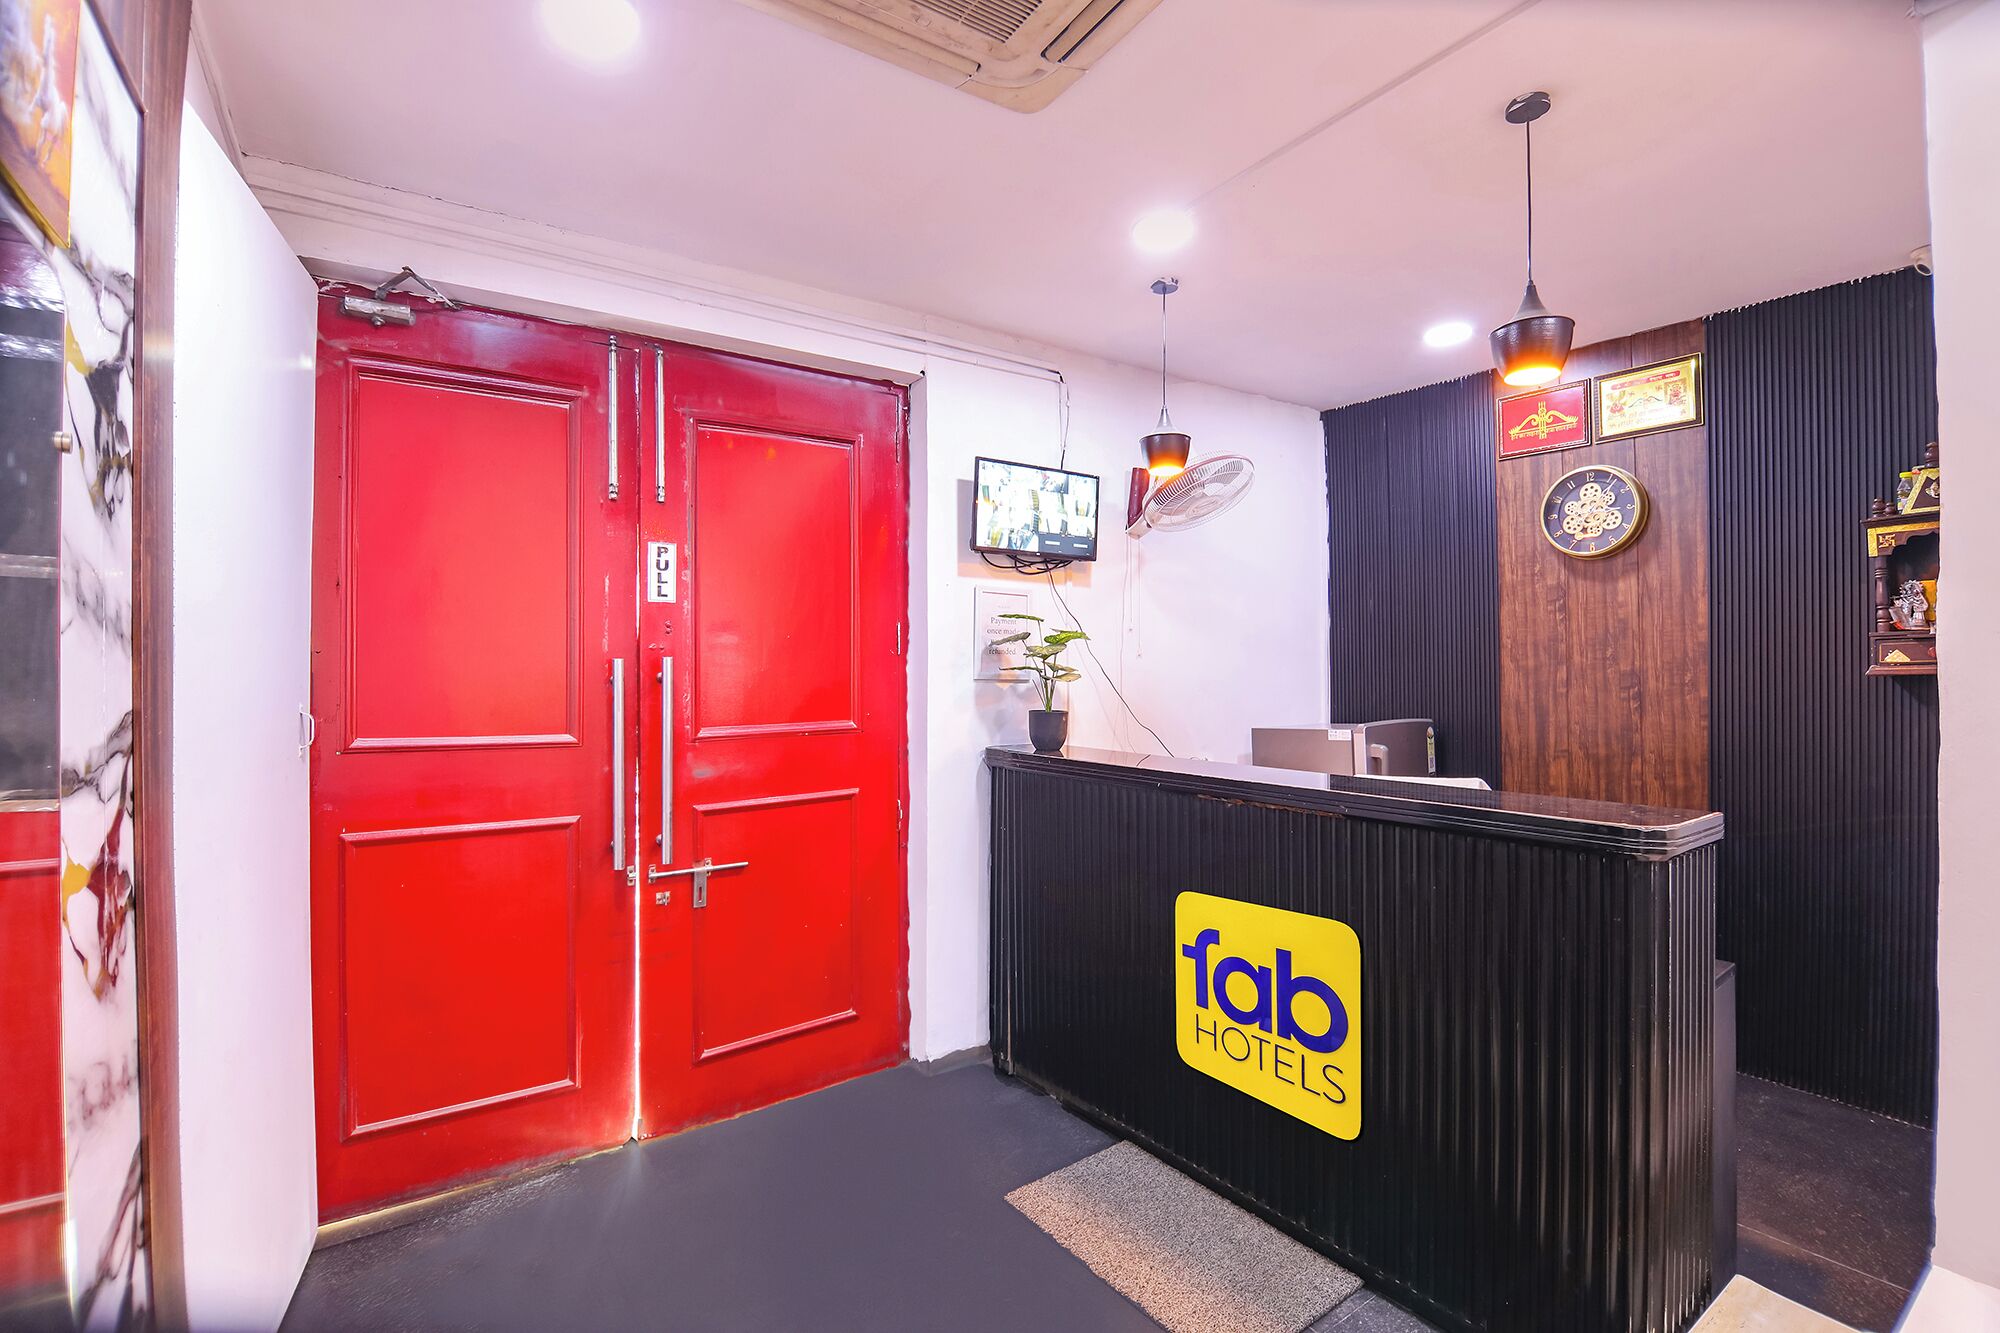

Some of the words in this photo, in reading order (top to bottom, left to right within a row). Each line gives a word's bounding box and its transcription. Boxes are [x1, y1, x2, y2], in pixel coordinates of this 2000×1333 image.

[1567, 480, 1576, 489] 11
[1586, 472, 1595, 481] 12
[656, 546, 669, 597] PULL
[991, 617, 1017, 626] Payment
[1182, 928, 1349, 1053] fab
[1195, 1013, 1346, 1104] HOTELS
